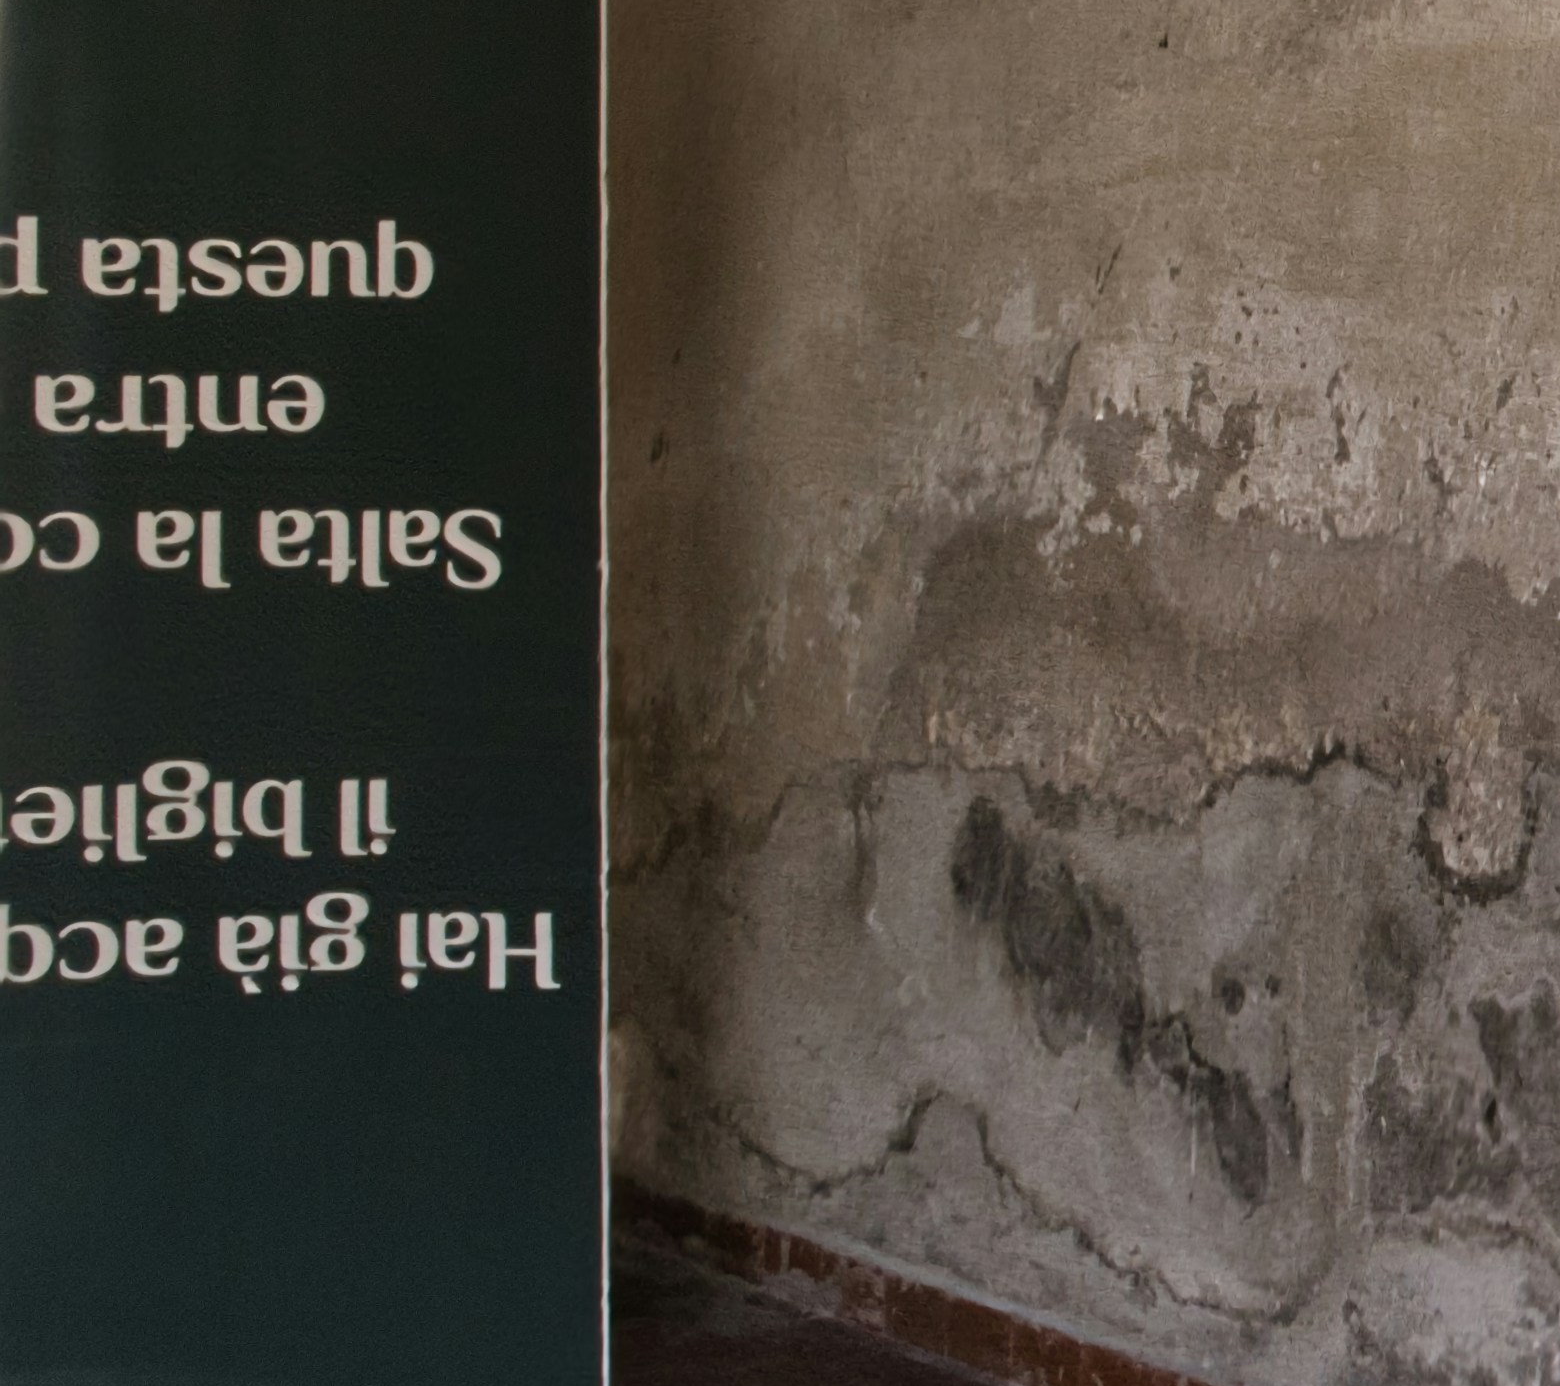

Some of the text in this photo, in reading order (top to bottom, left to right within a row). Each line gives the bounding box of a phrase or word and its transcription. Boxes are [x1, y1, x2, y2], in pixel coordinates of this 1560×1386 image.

[81, 219, 435, 313] questa
[34, 373, 326, 448] entra
[136, 509, 232, 589] la
[258, 508, 504, 590] Salta
[0, 759, 397, 863] il biglie
[0, 891, 561, 994] Hai già acq
